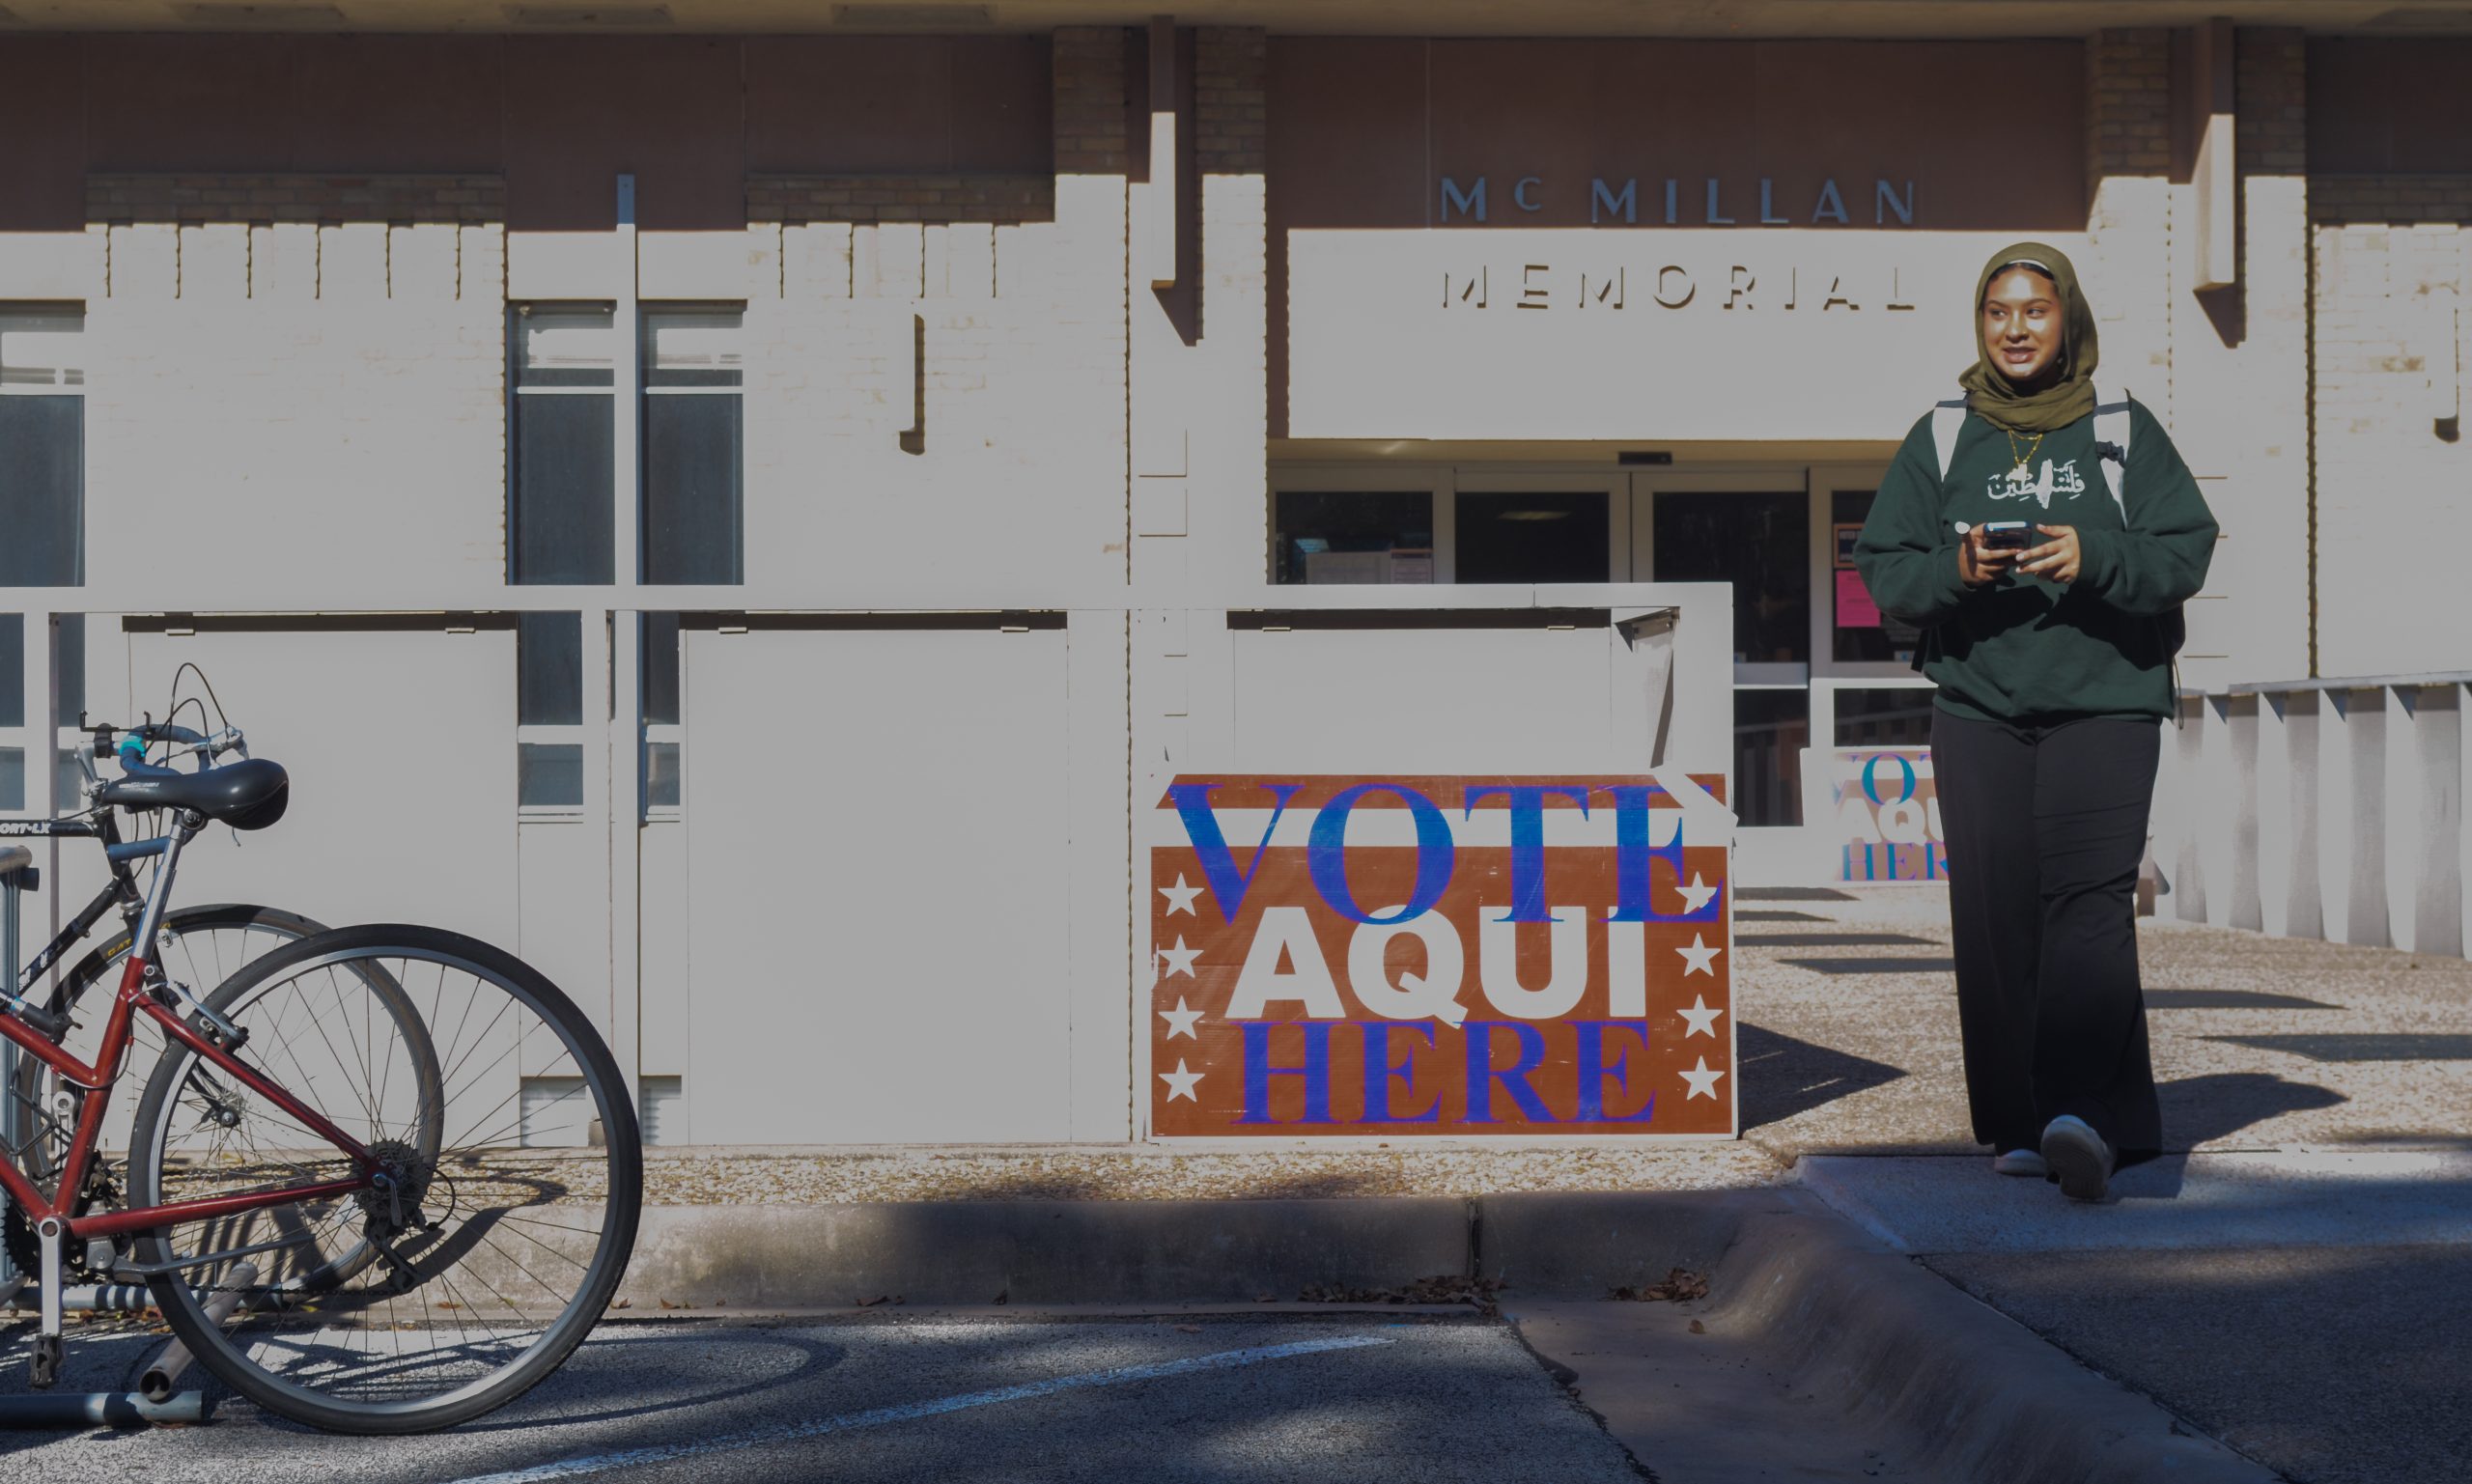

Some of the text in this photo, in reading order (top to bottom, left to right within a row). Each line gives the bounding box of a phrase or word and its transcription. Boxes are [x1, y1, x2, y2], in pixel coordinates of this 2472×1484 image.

[1591, 178, 1914, 224] MILLAN
[1443, 264, 1916, 311] MEMORIAL
[1169, 783, 1725, 927] VOTE
[1224, 904, 1647, 1030] AQUI
[1228, 1020, 1657, 1125] HERE
